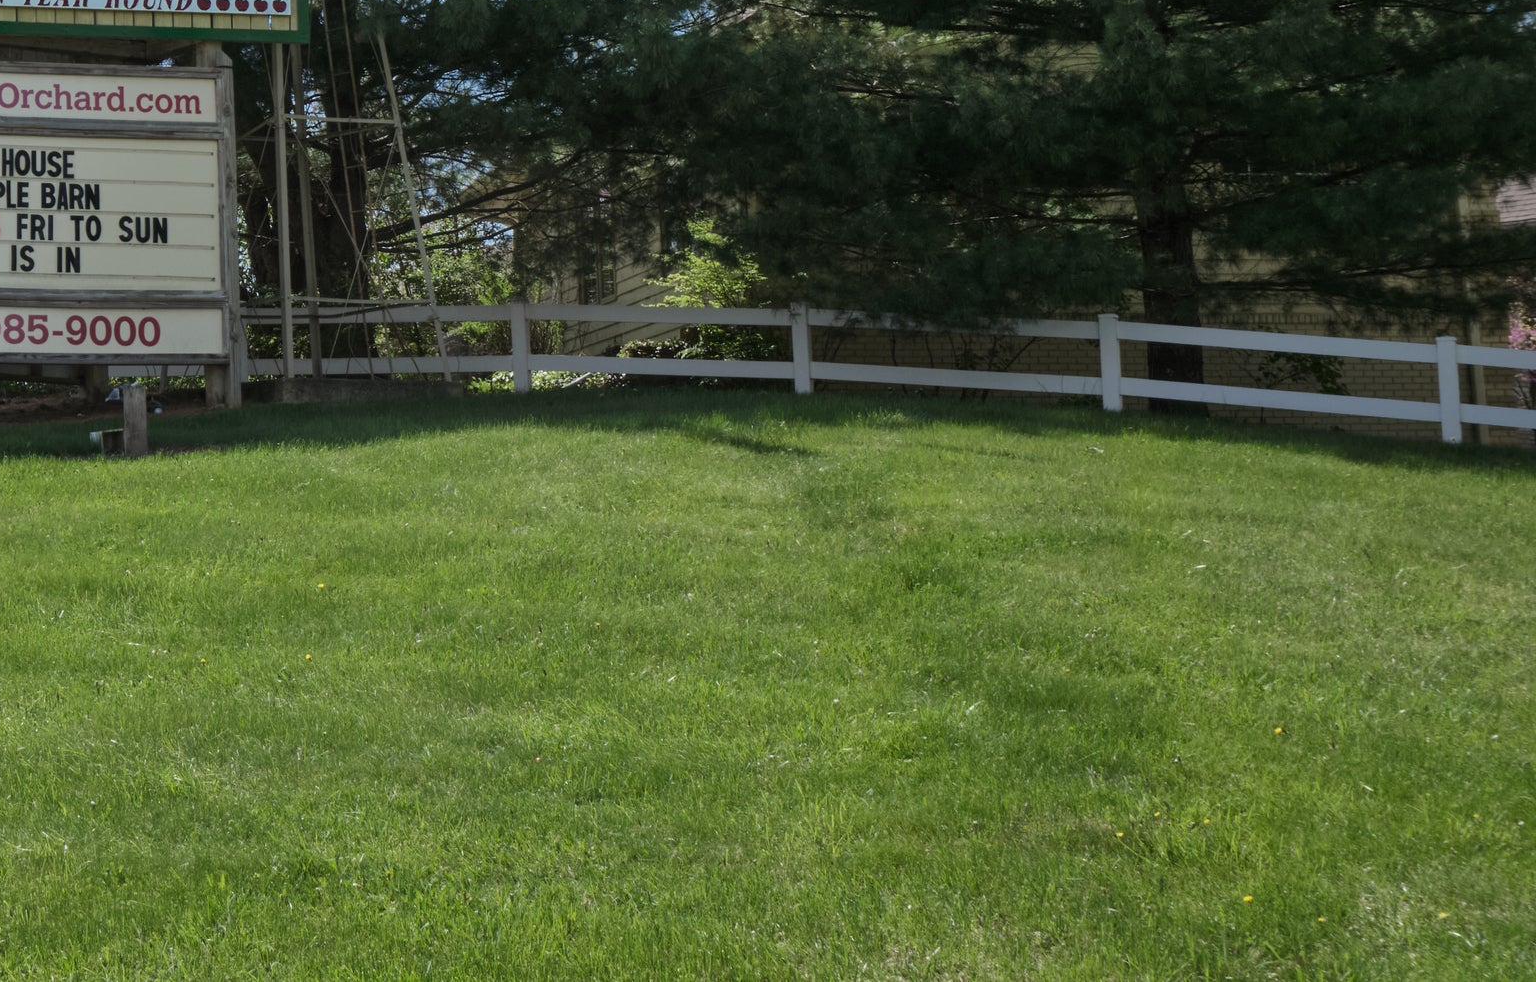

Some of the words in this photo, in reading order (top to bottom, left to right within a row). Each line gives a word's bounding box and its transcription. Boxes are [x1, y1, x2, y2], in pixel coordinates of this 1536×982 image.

[1, 148, 75, 179] HOUSE
[41, 182, 101, 211] BARN
[16, 214, 54, 241] FRI
[70, 215, 102, 242] TO
[119, 215, 168, 244] SUN
[11, 244, 35, 273] IS
[57, 246, 81, 274] IN
